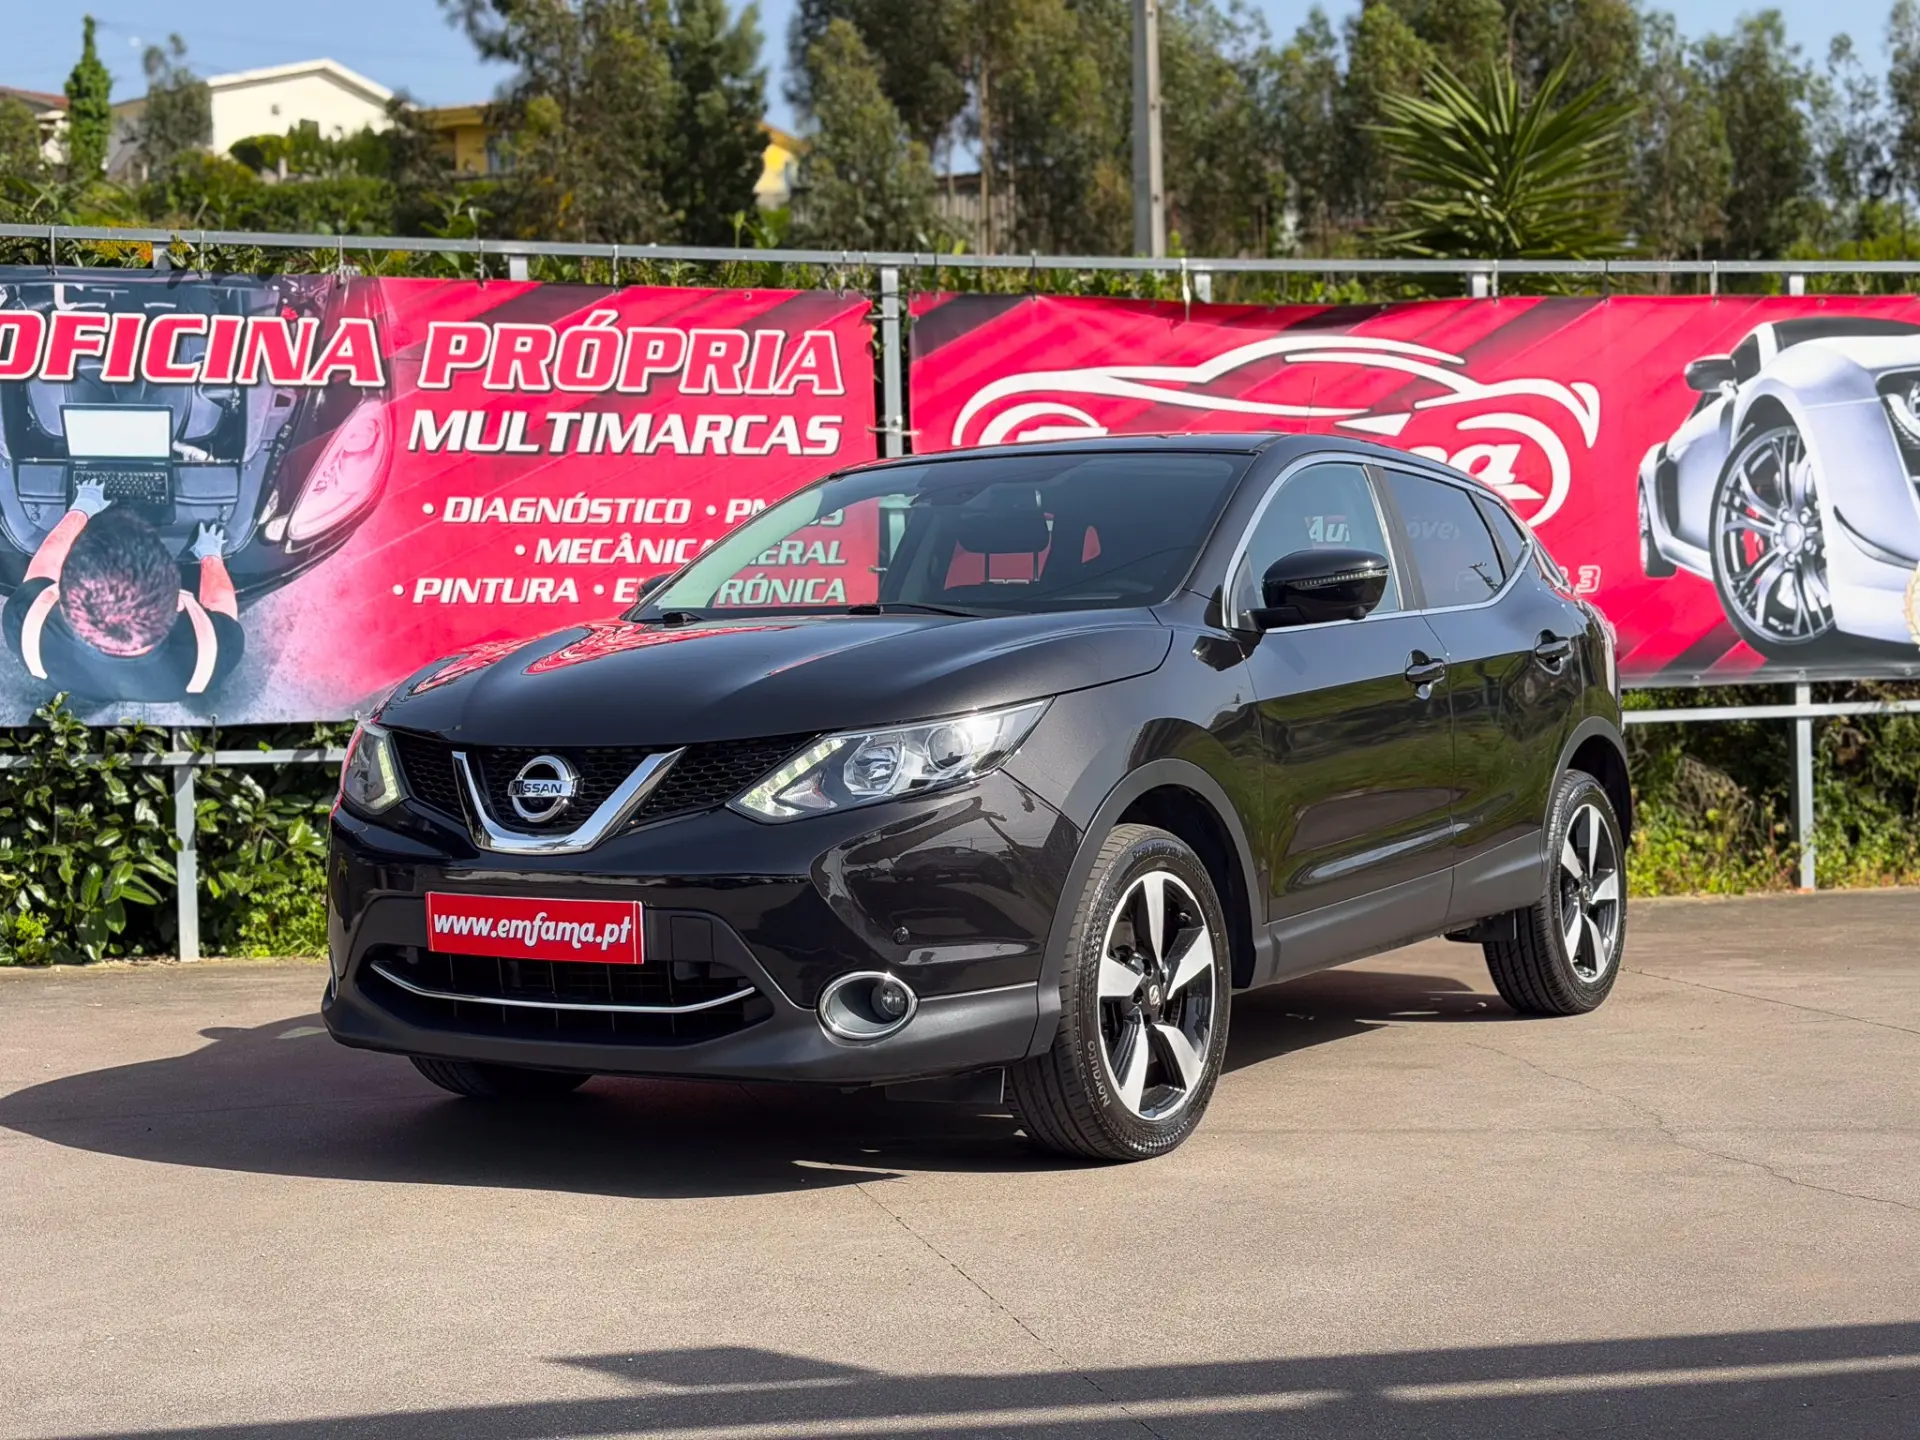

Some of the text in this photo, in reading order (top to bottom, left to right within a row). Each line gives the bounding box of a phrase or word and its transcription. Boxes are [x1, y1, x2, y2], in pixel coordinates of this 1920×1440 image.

[0, 309, 845, 396] OFICINA PRÓPRIA
[408, 410, 844, 455] MULTIMARCAS
[443, 492, 692, 525] DIAGNÓSTICO
[749, 540, 847, 564] ERAL
[412, 577, 579, 604] PINTURA
[511, 783, 562, 795] NISSAN
[433, 911, 632, 951] www.emfama.pt
